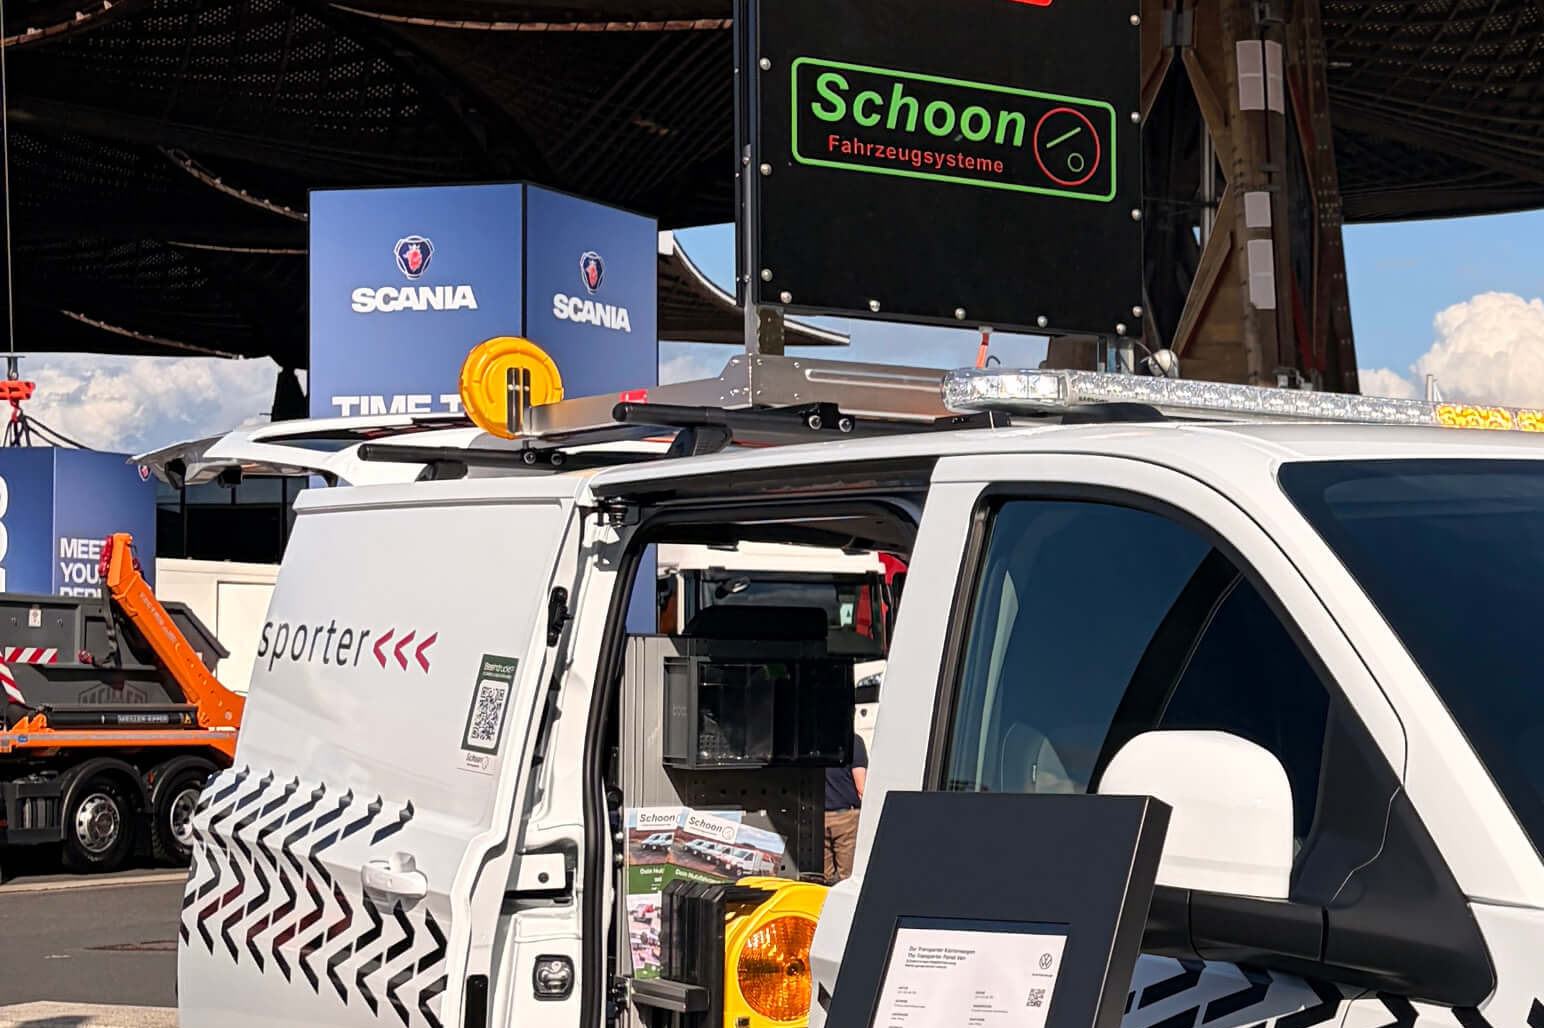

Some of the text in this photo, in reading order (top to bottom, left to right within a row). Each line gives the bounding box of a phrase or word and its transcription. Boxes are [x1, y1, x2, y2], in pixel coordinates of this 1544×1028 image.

[811, 72, 1026, 147] Schoon
[828, 134, 1004, 174] Fahrzeugsysteme
[351, 285, 478, 313] SCANIA
[553, 293, 632, 332] SCANIA
[60, 562, 102, 584] YOU
[257, 619, 370, 672] sporter
[639, 813, 675, 823] Schoon
[688, 816, 723, 834] Schoon
